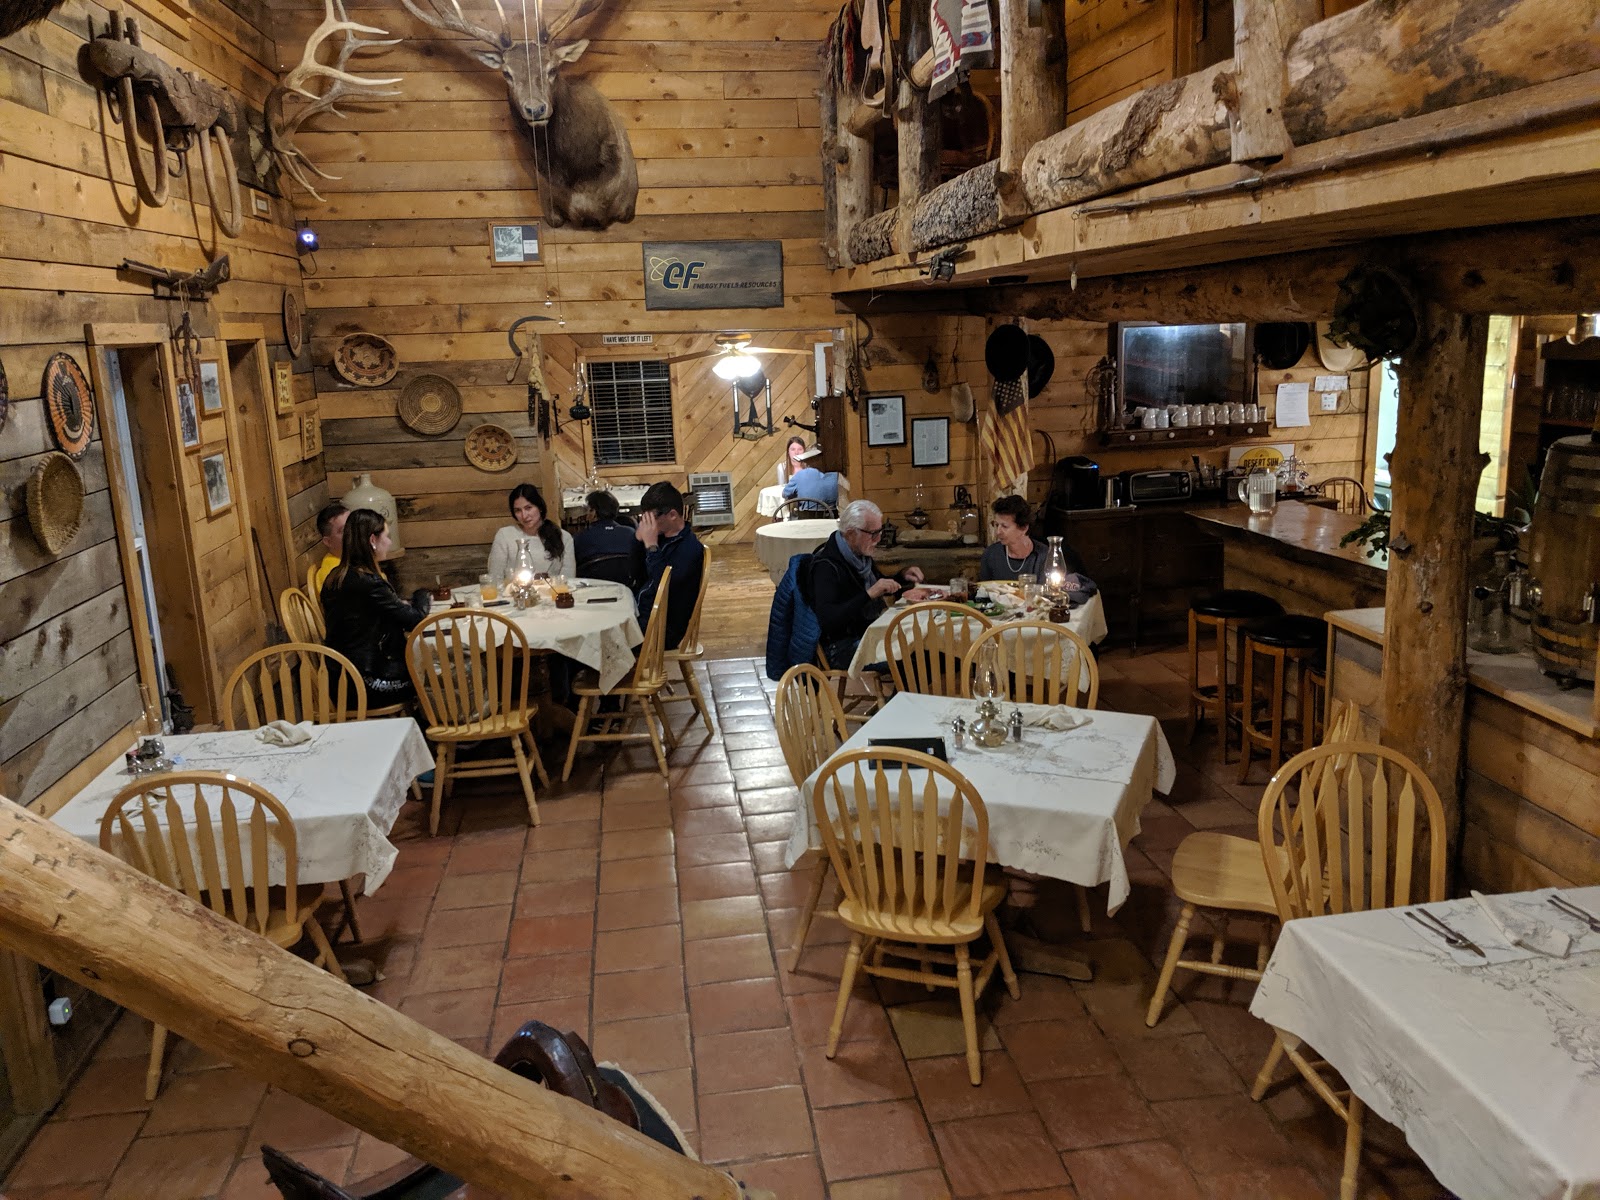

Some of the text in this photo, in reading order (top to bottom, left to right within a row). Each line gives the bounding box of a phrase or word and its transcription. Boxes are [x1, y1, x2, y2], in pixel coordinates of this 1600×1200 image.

[718, 282, 739, 290] FUELS
[1243, 457, 1280, 468] DESERT SUN
